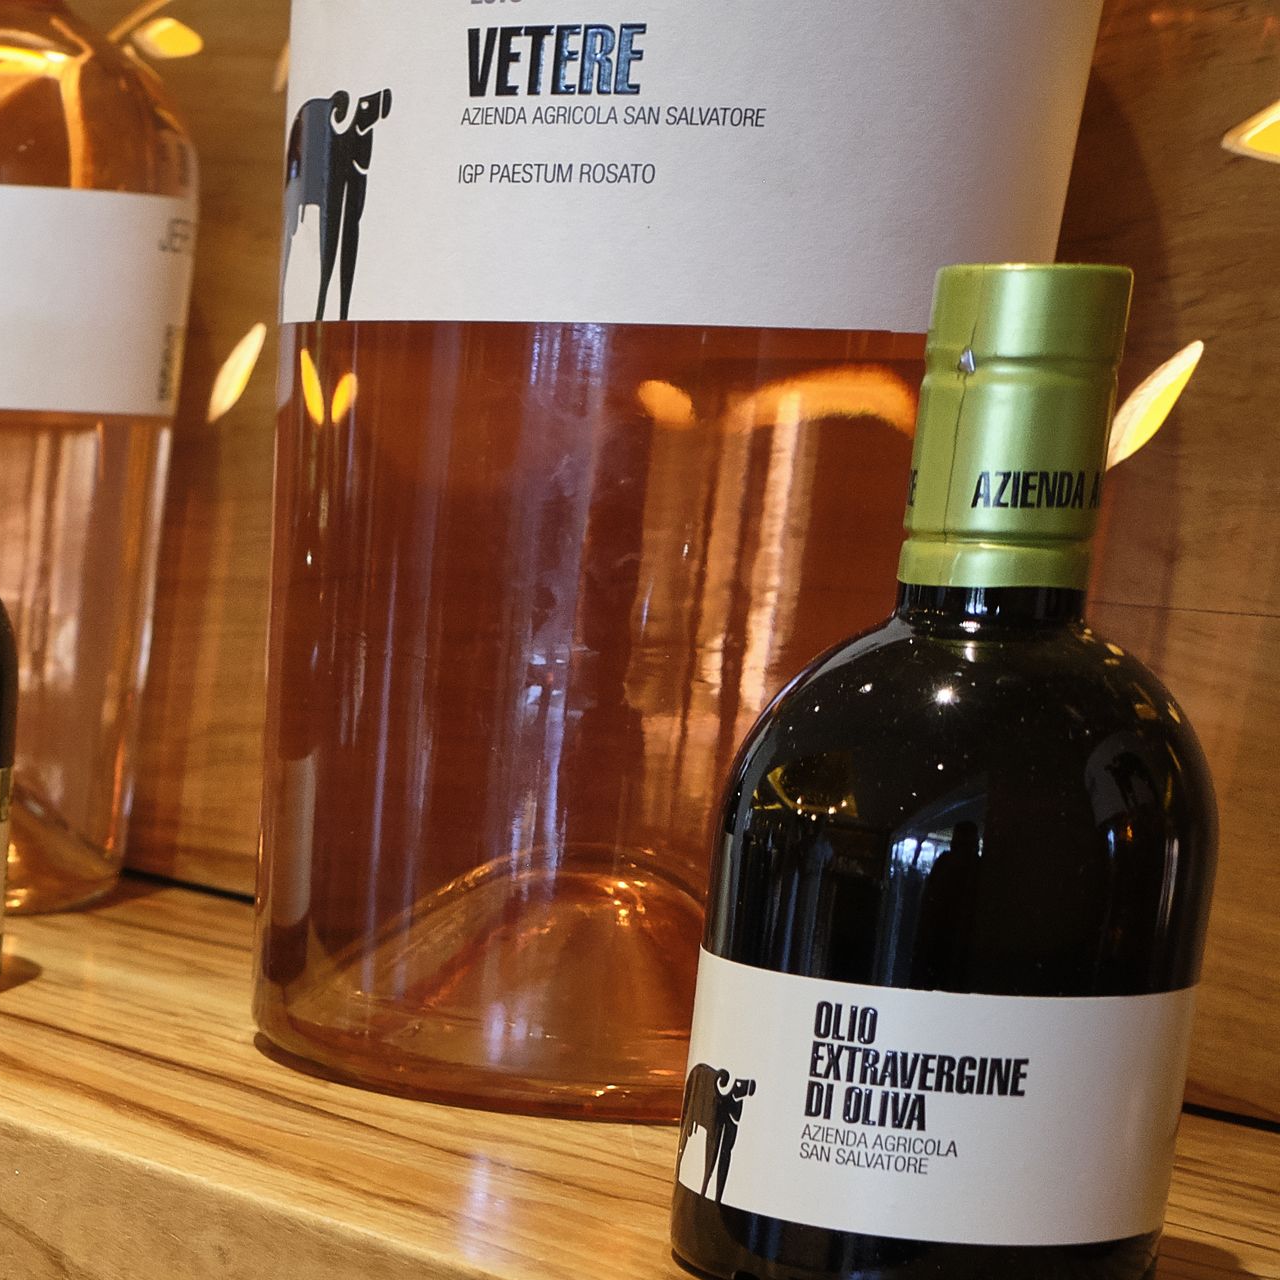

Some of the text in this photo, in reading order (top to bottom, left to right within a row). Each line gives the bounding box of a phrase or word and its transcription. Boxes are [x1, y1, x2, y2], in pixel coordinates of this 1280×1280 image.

[467, 23, 647, 97] VETERE
[460, 105, 767, 128] AZIENDA AGRICOLA SAN SALVATORE
[458, 163, 656, 184] IGP PAESTUM ROSATO
[971, 470, 1085, 508] AZIENDA
[814, 1000, 878, 1045] OLIO
[809, 1040, 1030, 1097] EXTRAVERGINE
[804, 1080, 926, 1131] DI OLIVA
[800, 1142, 929, 1175] SAN SALVATORE
[801, 1123, 958, 1158] AZIENDA AGRICOLA
